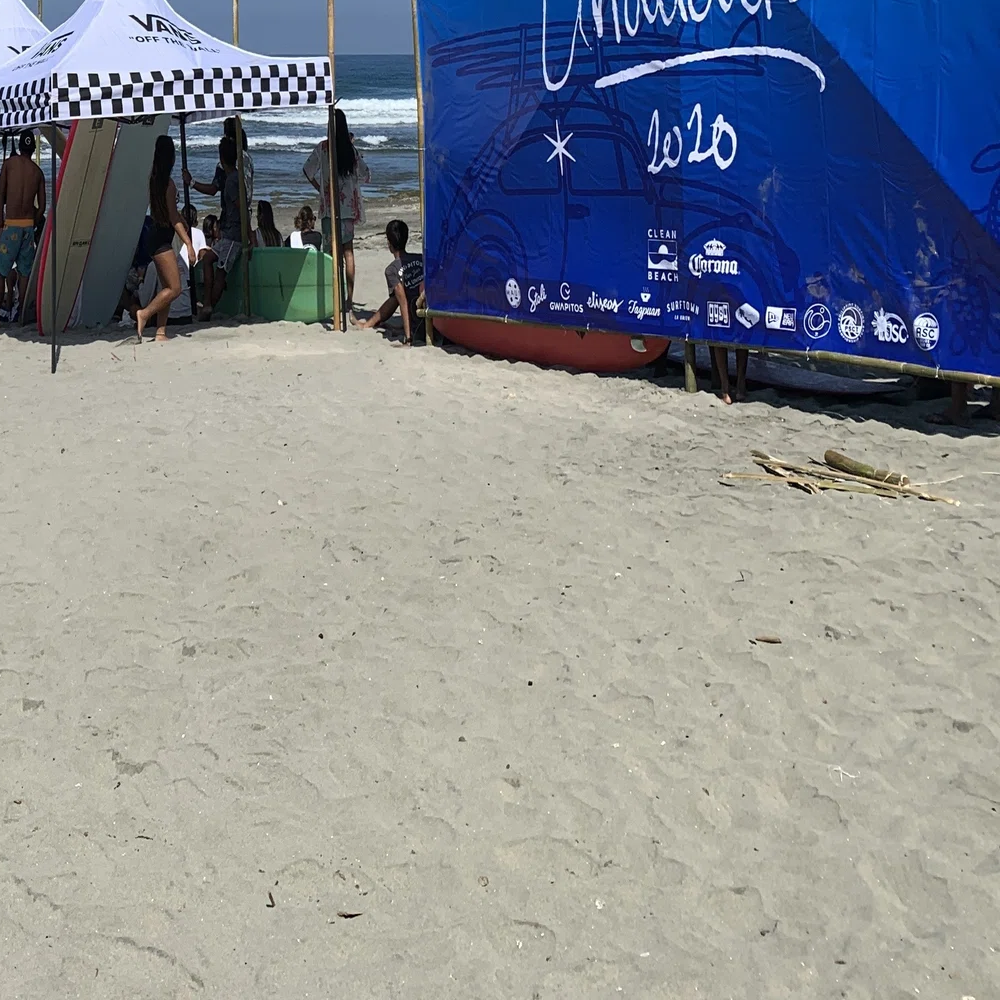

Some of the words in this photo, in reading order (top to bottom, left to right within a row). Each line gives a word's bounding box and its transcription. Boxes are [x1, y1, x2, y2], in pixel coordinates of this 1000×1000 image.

[648, 103, 737, 174] 2020
[647, 229, 677, 239] CLEAN
[647, 271, 679, 282] BEACH
[549, 301, 584, 314] GWAPITOS
[628, 300, 660, 320] Tagpuan
[666, 300, 699, 316] SURFTOWN
[916, 327, 935, 339] ASC
